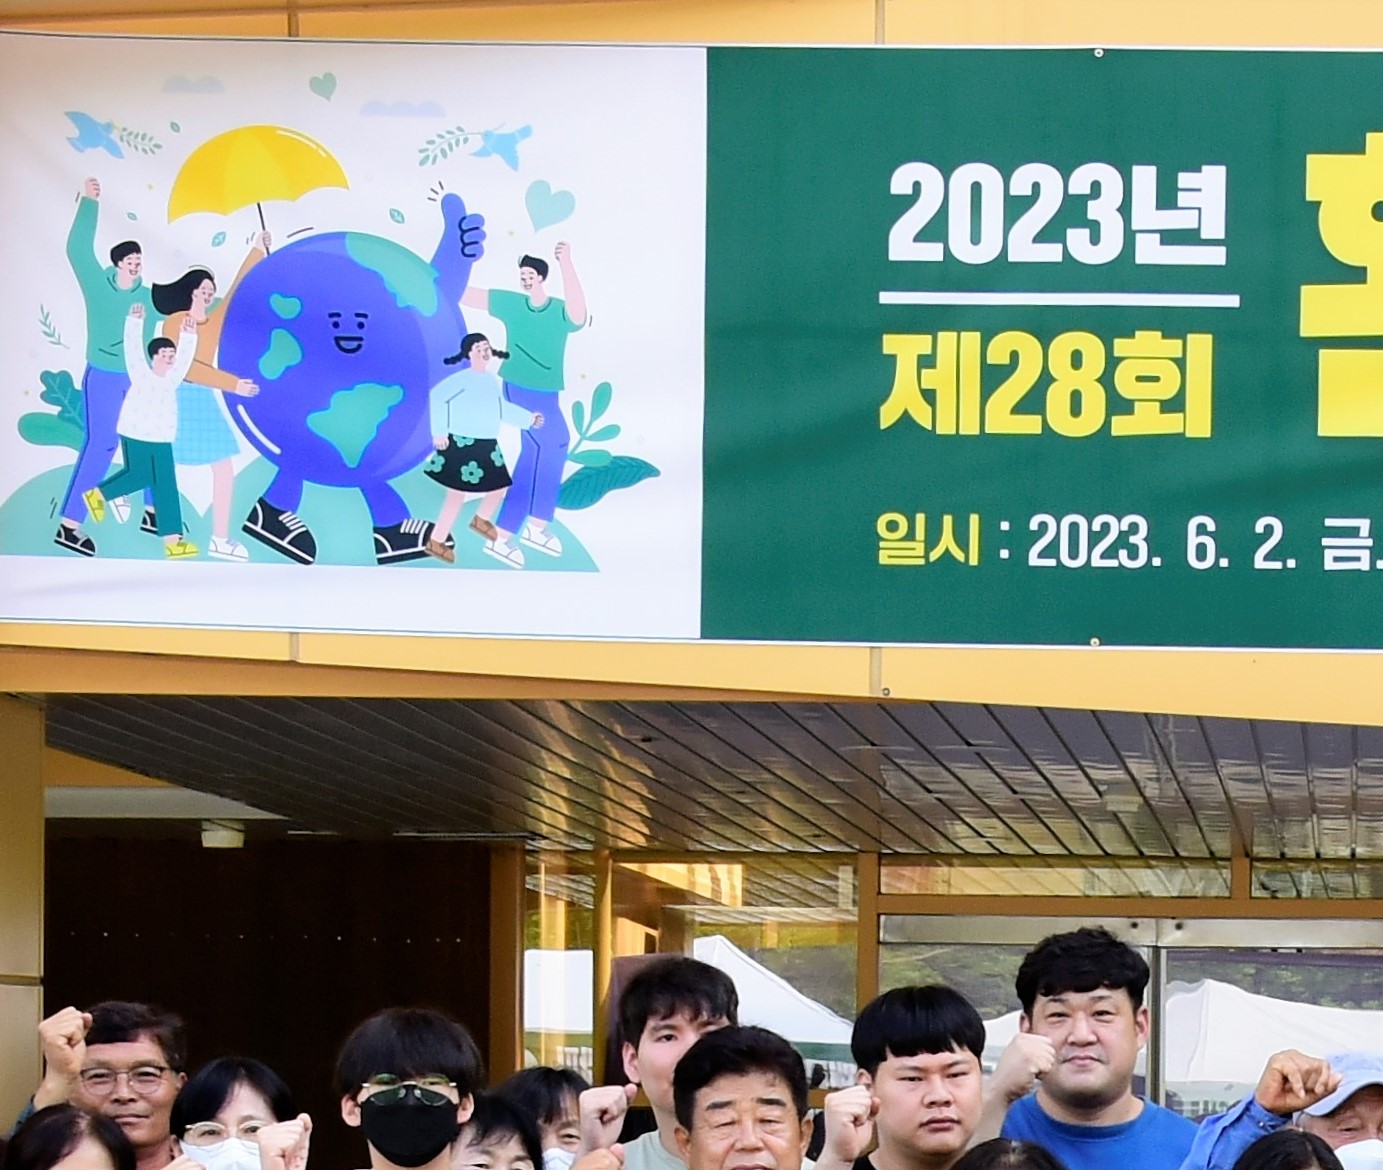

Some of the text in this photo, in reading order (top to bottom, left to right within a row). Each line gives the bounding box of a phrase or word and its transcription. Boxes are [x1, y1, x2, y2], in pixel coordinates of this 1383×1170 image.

[888, 161, 1227, 266] 2023년
[879, 330, 1213, 438] 제28회
[876, 512, 980, 566] 일시
[1028, 513, 1162, 569] 2023.
[1187, 515, 1229, 570] 6.
[1254, 516, 1296, 570] 2.
